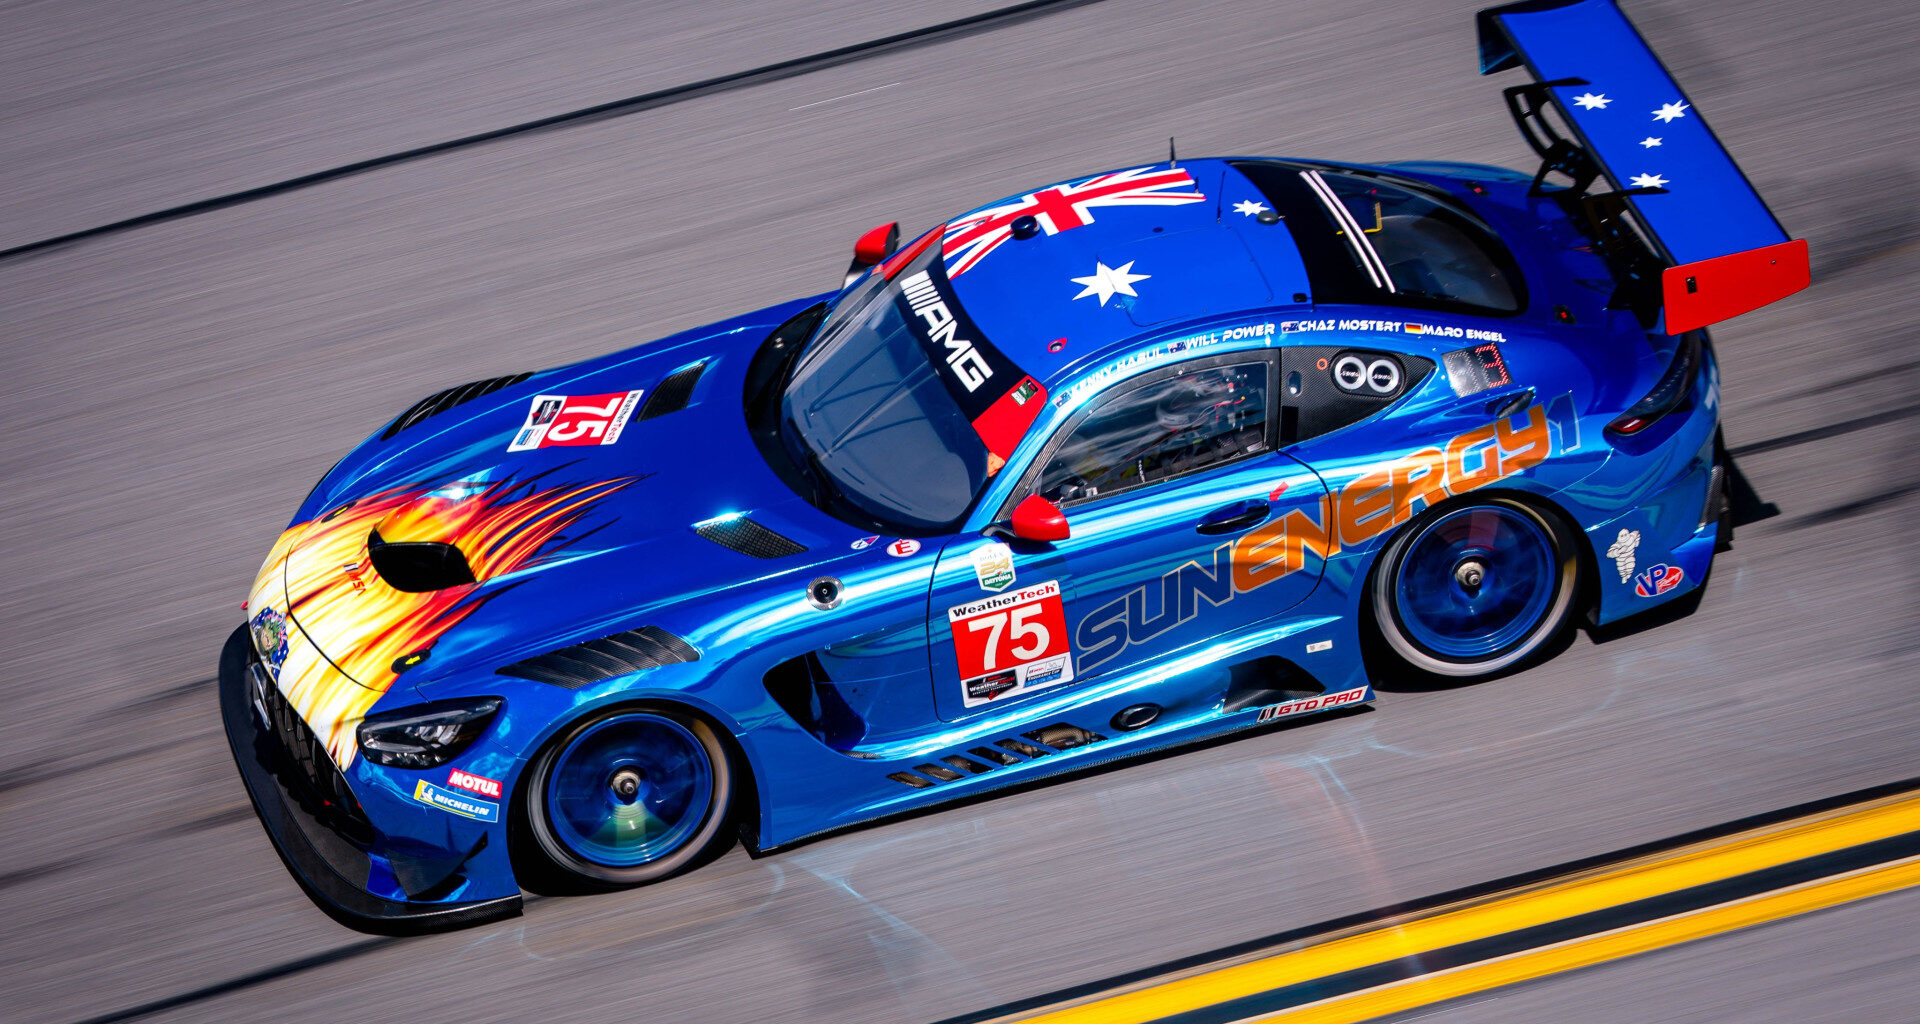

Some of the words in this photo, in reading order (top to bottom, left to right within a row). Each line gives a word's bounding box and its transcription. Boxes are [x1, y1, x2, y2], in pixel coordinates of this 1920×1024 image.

[1186, 331, 1219, 351] WILL
[1222, 323, 1275, 344] POWER
[1298, 319, 1336, 333] CHAZ
[1338, 319, 1402, 333] MOSTERT
[1422, 324, 1463, 339] MARO
[1465, 329, 1507, 343] ENGEL
[1071, 365, 1113, 397] KENNY
[547, 397, 623, 442] 75
[606, 391, 639, 443] WeatherTech
[1075, 390, 1582, 677] SUNENERGY1
[980, 557, 1010, 576] 24
[984, 573, 1013, 586] DAYTONA
[1635, 564, 1668, 597] VP
[953, 583, 1055, 618] WeatherTech
[967, 602, 1051, 671] 75
[1278, 699, 1319, 716] GTD
[1321, 689, 1363, 707] PRO
[449, 771, 500, 797] MOTUL
[434, 794, 490, 816] MICHELIN
